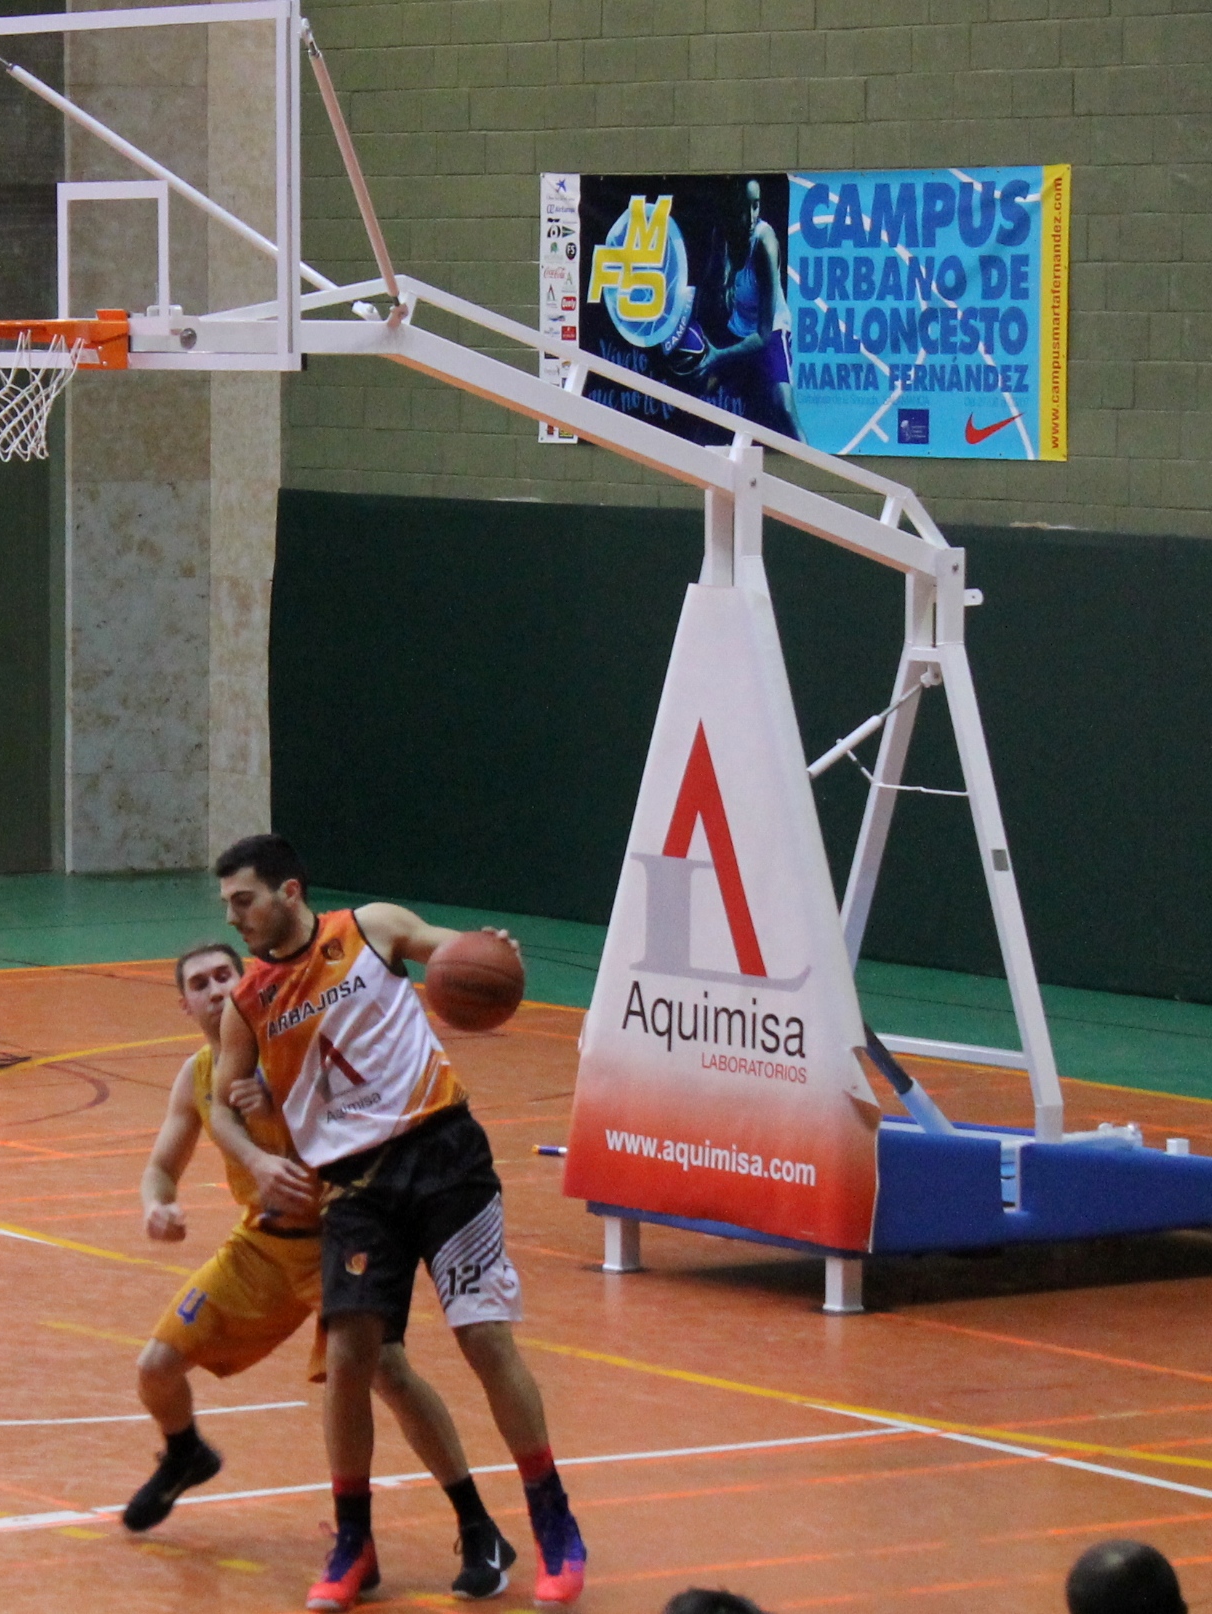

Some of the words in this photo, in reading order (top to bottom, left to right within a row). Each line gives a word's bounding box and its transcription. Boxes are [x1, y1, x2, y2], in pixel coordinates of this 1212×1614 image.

[799, 179, 1032, 250] CAMPUS
[799, 255, 968, 301] URBANO
[979, 254, 1030, 301] DE
[797, 306, 1029, 356] BALONCESTO
[1050, 176, 1063, 450] www.campusmartafernandez.com
[797, 362, 880, 392] MARTA
[889, 356, 1030, 393] FERNÁNDEZ
[268, 975, 368, 1040] ARBAJOSA
[622, 981, 807, 1059] Aquimisa
[701, 1053, 808, 1085] LABORATORIOS
[605, 1129, 816, 1187] www.aquimisa.com
[444, 1264, 482, 1297] 12
